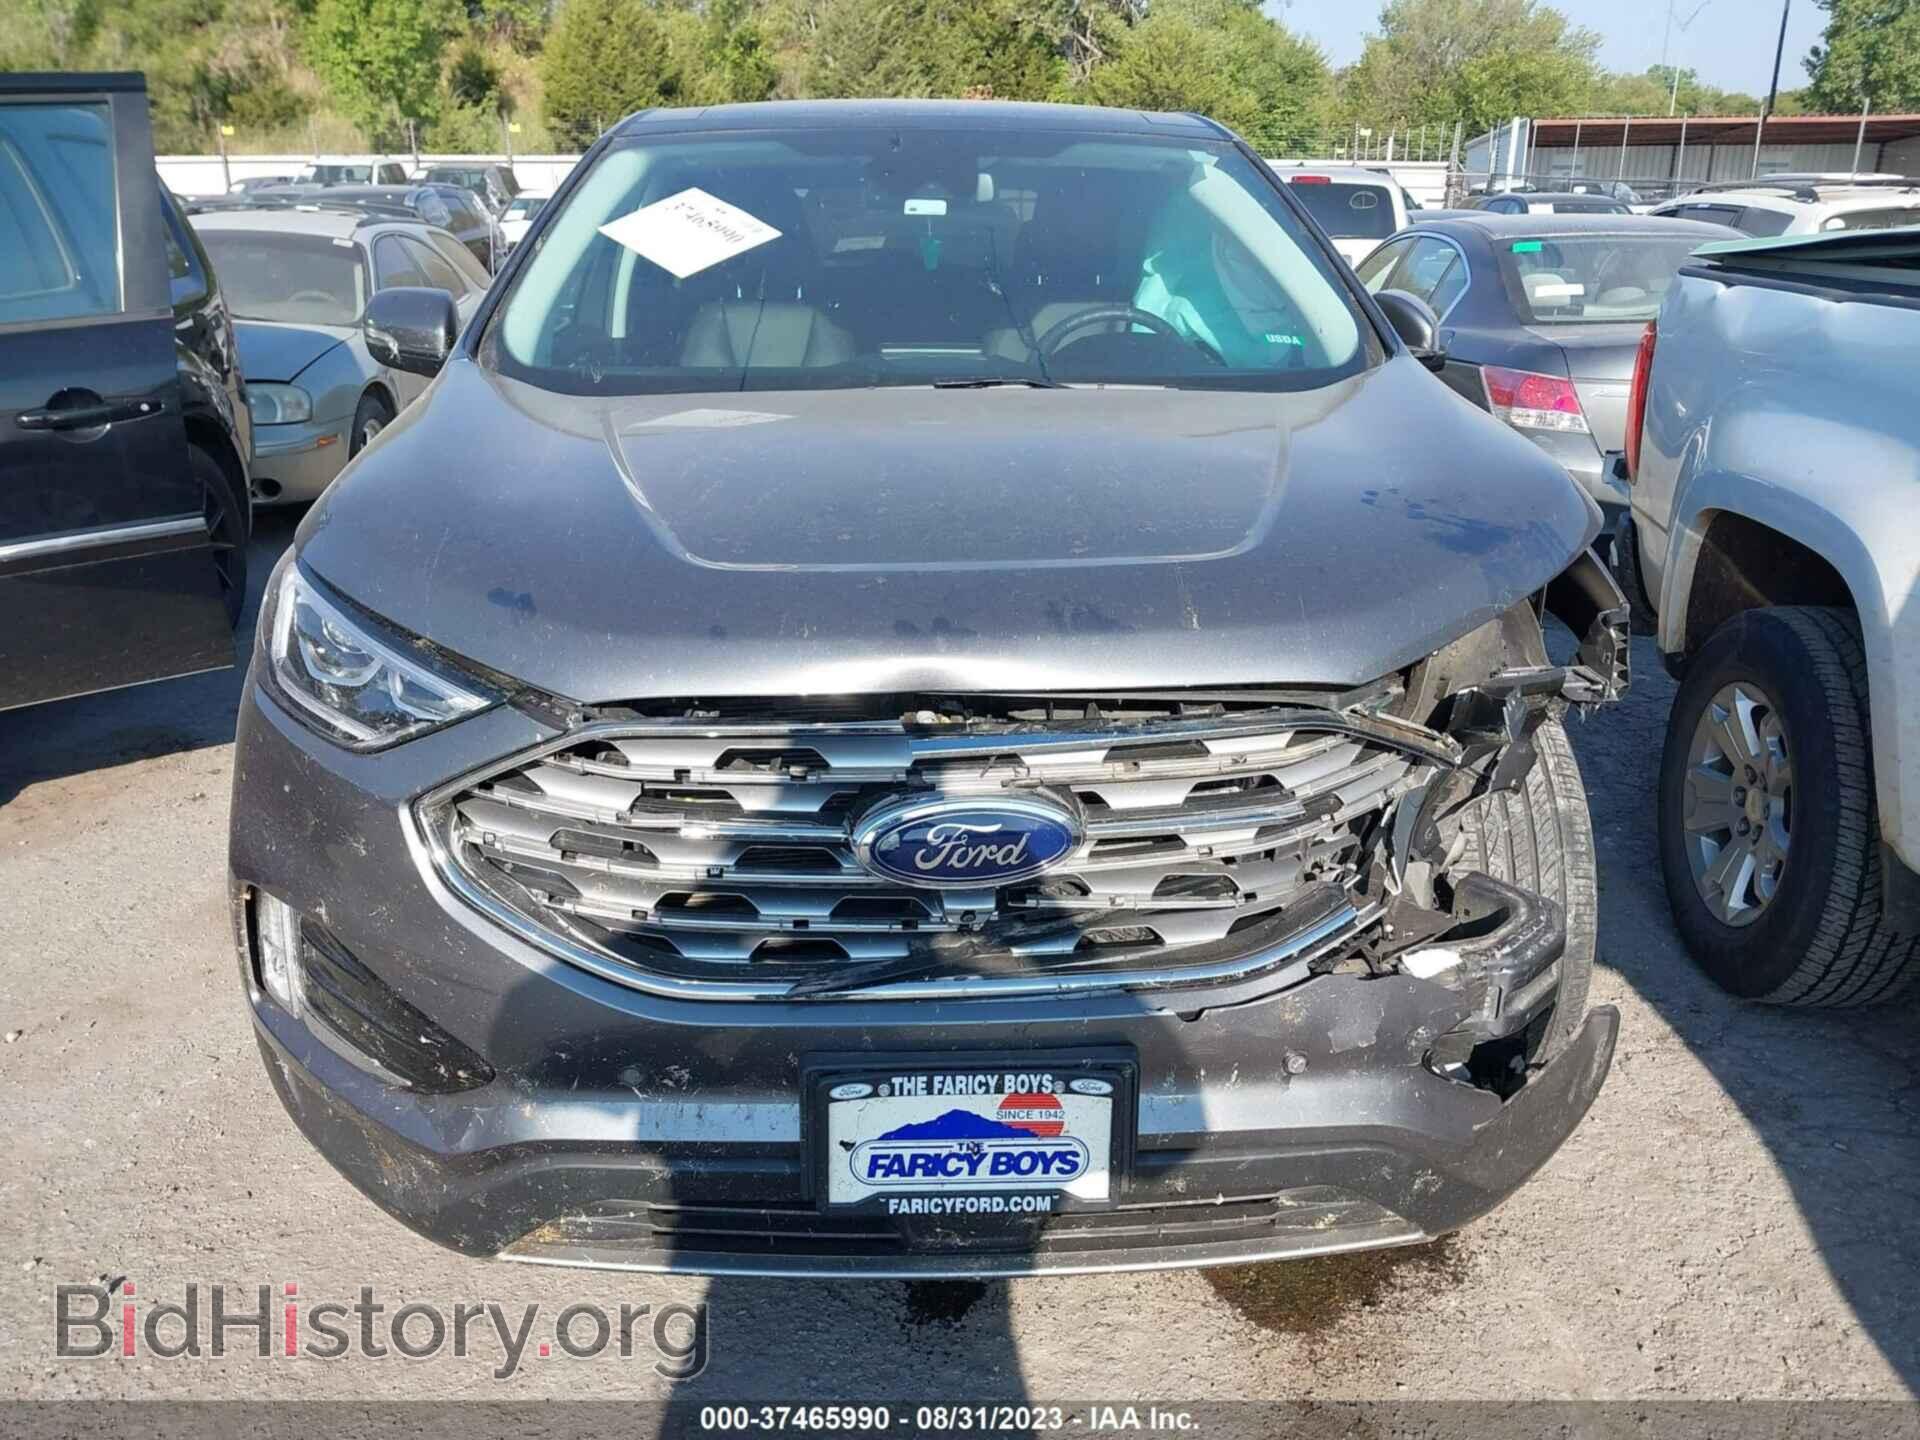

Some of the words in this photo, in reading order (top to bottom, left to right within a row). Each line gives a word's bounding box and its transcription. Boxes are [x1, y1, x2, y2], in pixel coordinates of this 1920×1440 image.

[915, 823, 1031, 870] Ford
[838, 1086, 865, 1098] Ford
[892, 1076, 928, 1097] THE
[933, 1075, 998, 1096] FARICY
[1004, 1074, 1053, 1095] BOYS
[996, 1110, 1034, 1120] SINCE
[1039, 1110, 1066, 1119] 1942
[867, 1152, 988, 1178] FARICY
[990, 1150, 1080, 1177] BOYS
[888, 1196, 1051, 1215] FARICYFORD.COM
